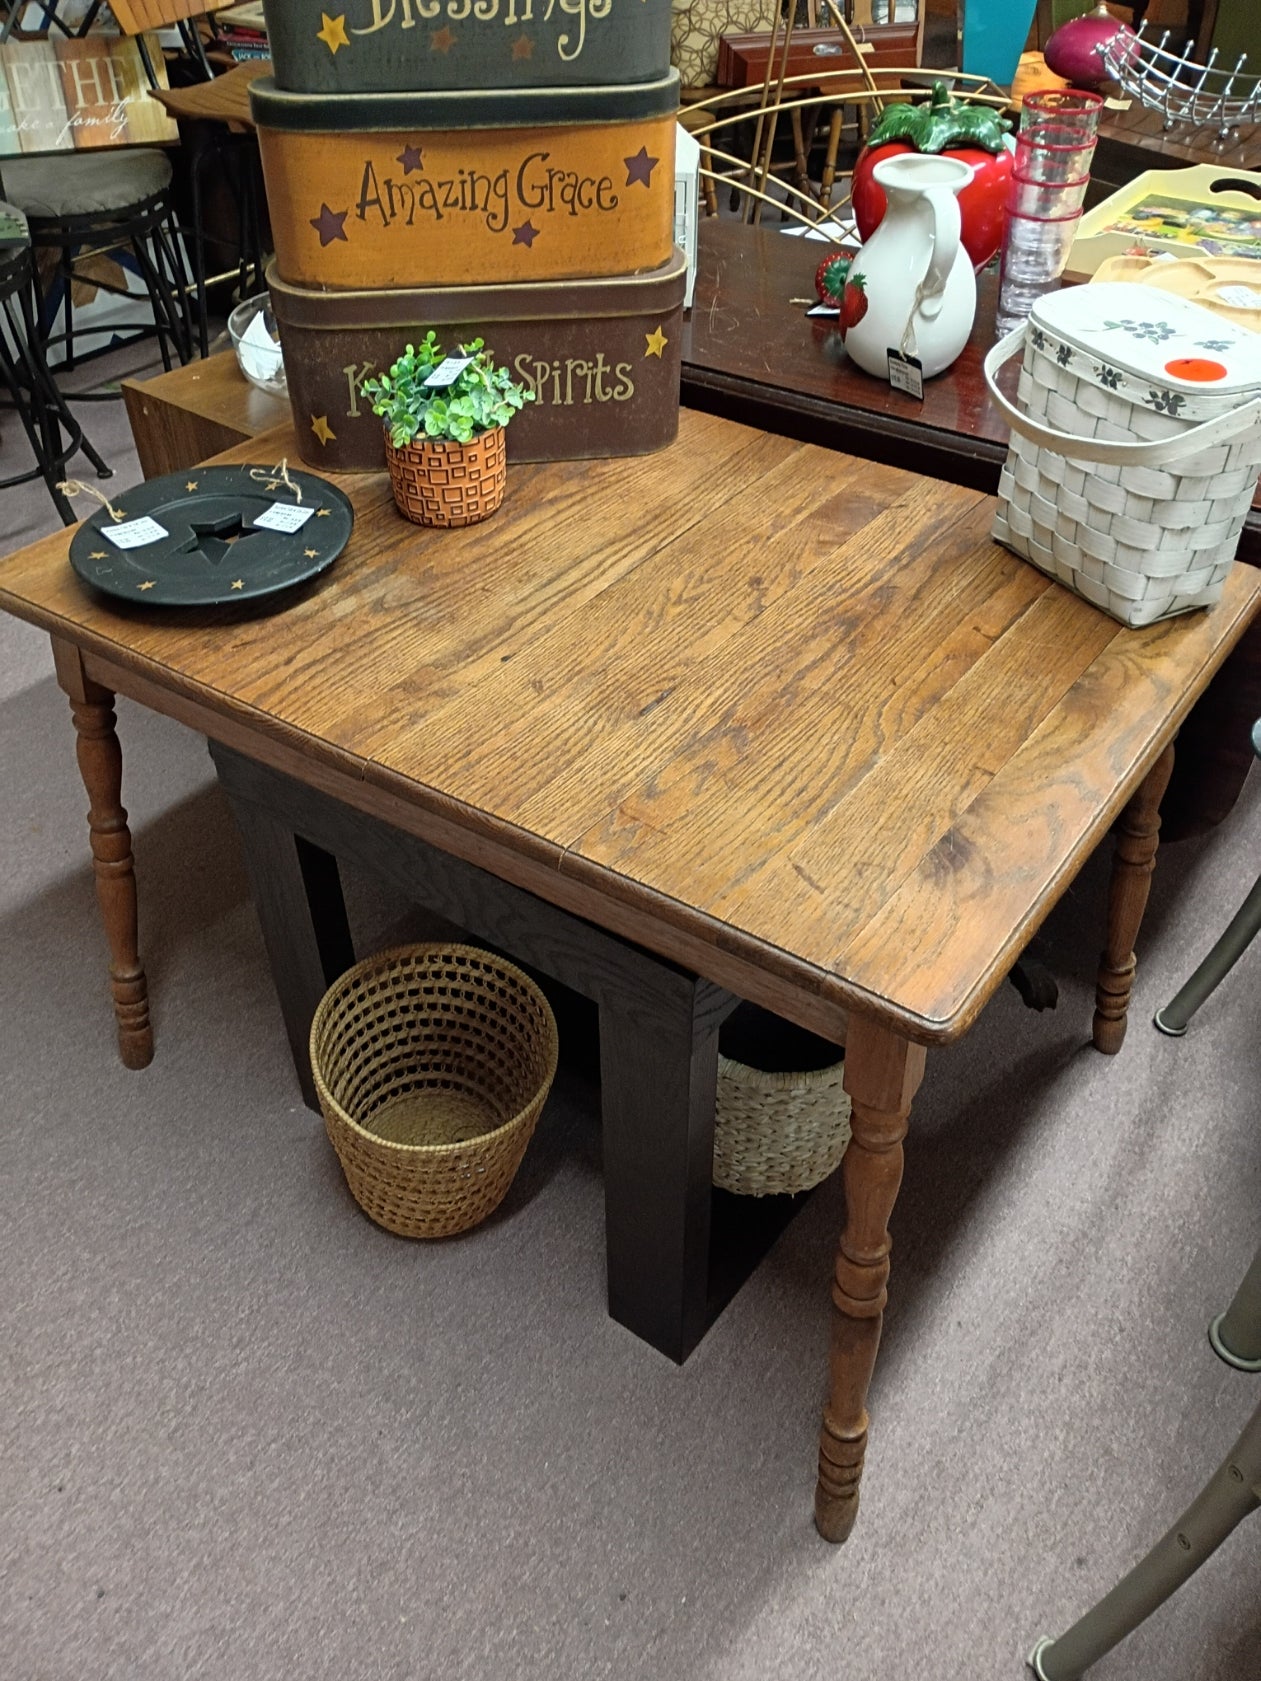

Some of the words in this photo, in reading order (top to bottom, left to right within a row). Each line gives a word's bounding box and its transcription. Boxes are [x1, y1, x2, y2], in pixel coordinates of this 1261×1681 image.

[0, 56, 151, 112] ETHE
[0, 113, 40, 133] ake
[56, 97, 130, 145] family
[356, 160, 510, 233] Amazing
[516, 153, 619, 216] Grace
[514, 353, 635, 406] Spirits
